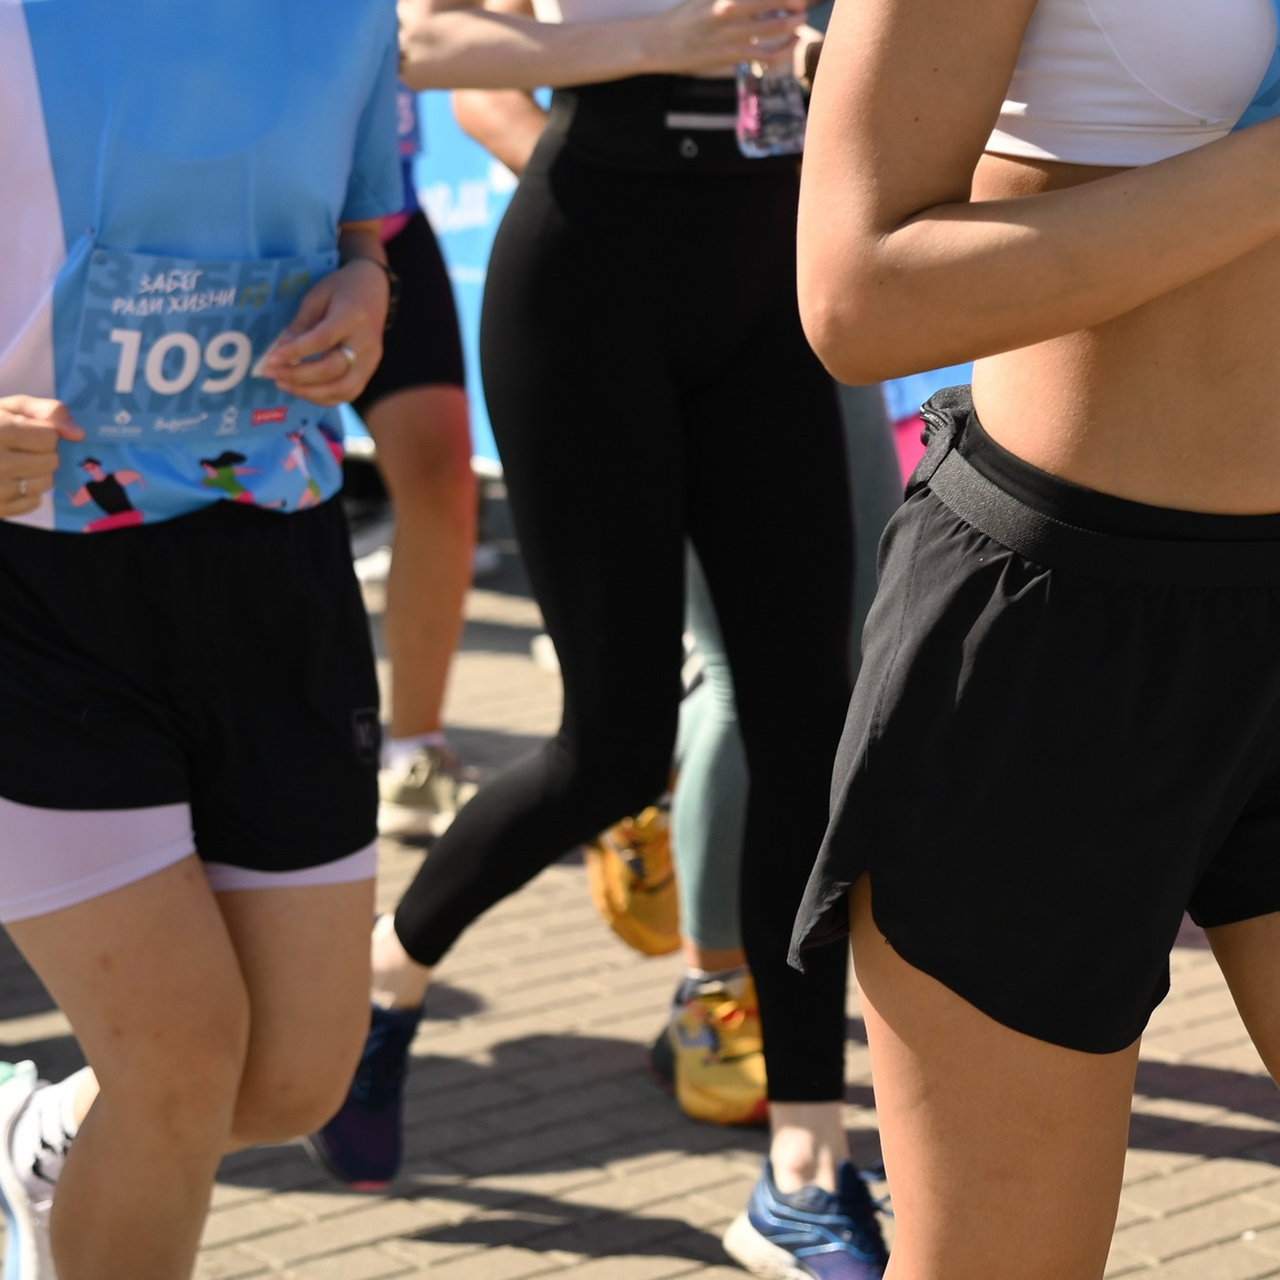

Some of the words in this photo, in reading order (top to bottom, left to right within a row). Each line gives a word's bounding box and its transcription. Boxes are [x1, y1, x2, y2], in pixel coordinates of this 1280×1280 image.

[139, 269, 204, 294] ЗАБЕГ
[112, 296, 163, 316] РАДИ
[167, 287, 237, 314] ЖИЗНИ
